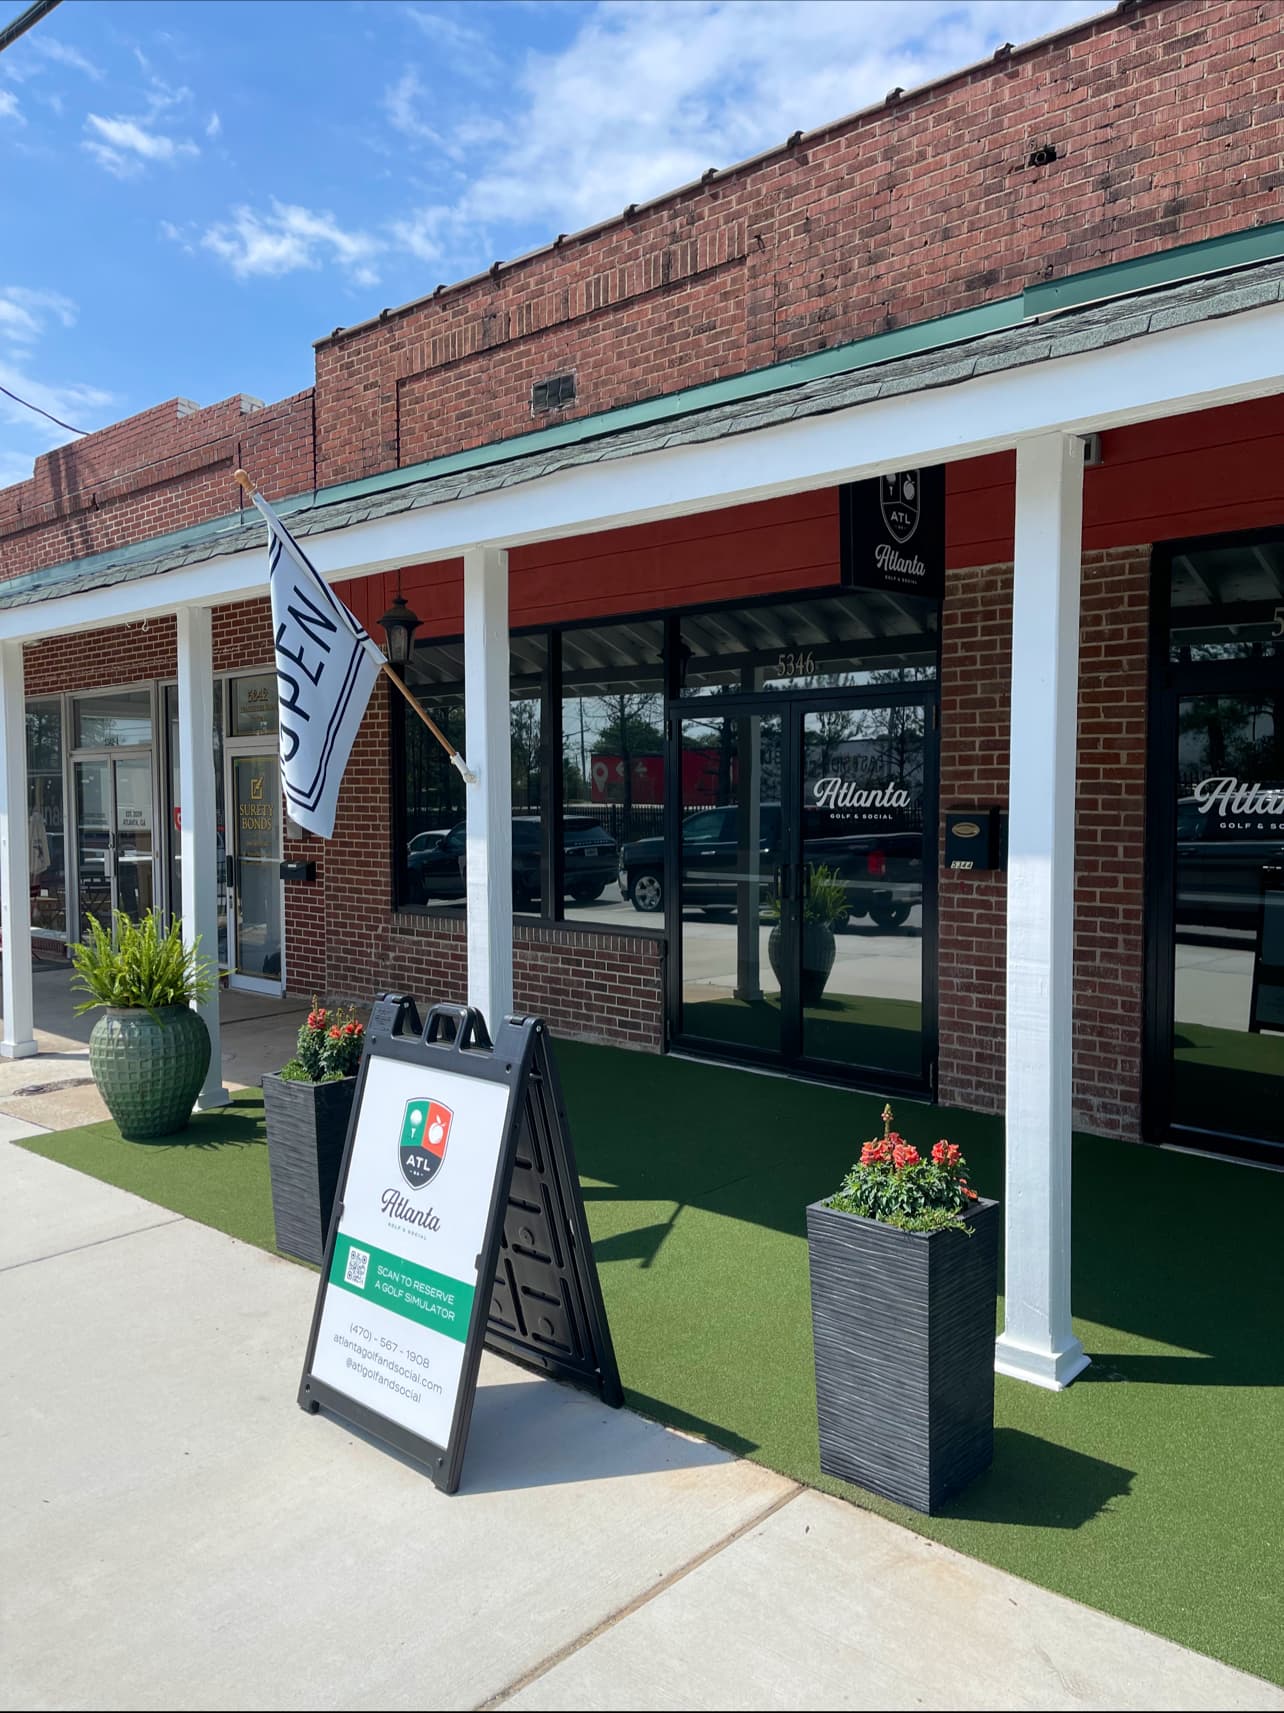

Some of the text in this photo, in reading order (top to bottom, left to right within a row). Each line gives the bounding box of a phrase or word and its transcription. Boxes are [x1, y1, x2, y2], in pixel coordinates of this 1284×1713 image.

[890, 511, 911, 524] ATL
[874, 544, 926, 576] Atlanta
[777, 652, 815, 676] 5346
[239, 803, 273, 816] SURETY
[813, 777, 911, 809] Atlanta
[1194, 777, 1284, 817] Atla
[242, 817, 273, 830] BONDS
[406, 1154, 431, 1172] ATL
[381, 1188, 441, 1232] Atlanta
[374, 1280, 456, 1321] A GOLF SIMULATOR
[377, 1265, 455, 1305] SCAN TO RESERVE
[349, 1322, 373, 1343] (470)
[379, 1337, 398, 1353] 567
[406, 1350, 430, 1369] 1908
[333, 1333, 443, 1395] atlantagolfandsocial.com
[345, 1357, 422, 1404] @atlgolfandsocial
